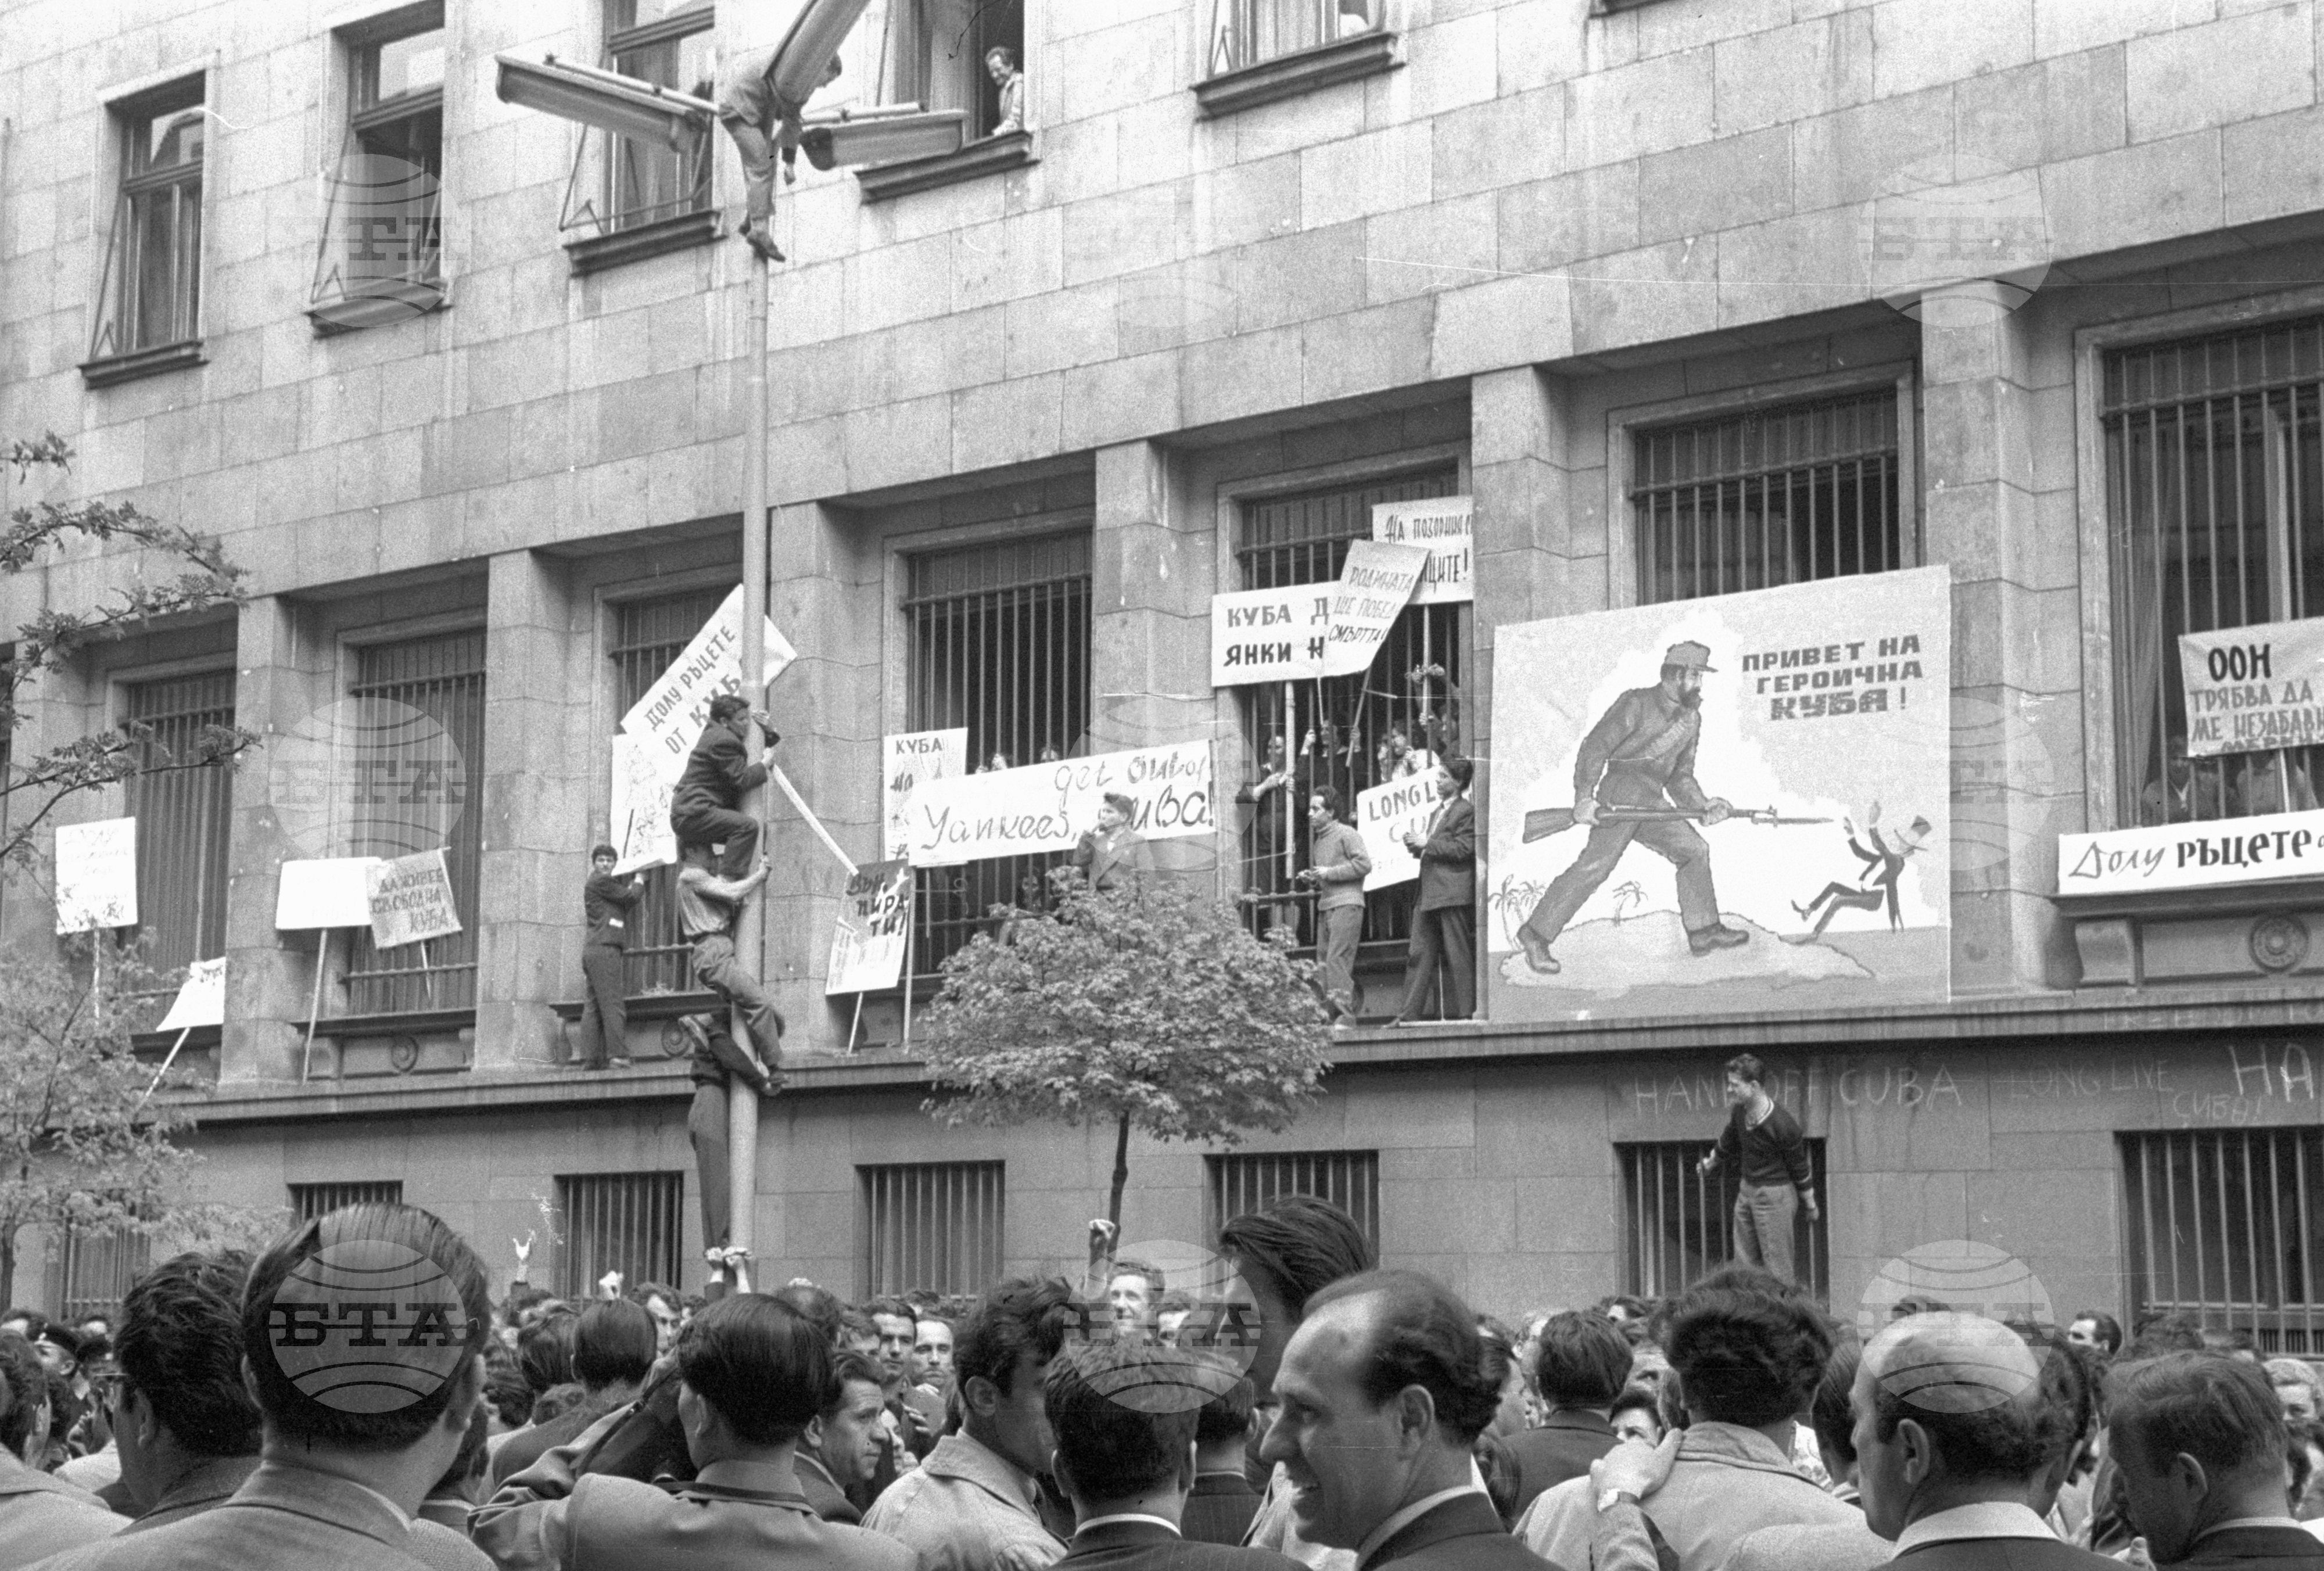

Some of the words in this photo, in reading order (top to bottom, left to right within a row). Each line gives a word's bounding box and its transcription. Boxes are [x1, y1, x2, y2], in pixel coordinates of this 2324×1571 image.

[1228, 604, 1292, 627] КУБА
[1224, 642, 1292, 667] ЯНКИ
[1743, 641, 1865, 672] ПРИВЕТ
[1878, 634, 1920, 657] НА
[2208, 643, 2272, 682] ООН
[644, 686, 682, 733] ДОЛУ
[680, 626, 736, 690] РЪЦЕТЕ
[1756, 660, 1923, 694] ГЕРОИЧНА
[2189, 684, 2272, 712] ТРЯБВА
[2280, 679, 2314, 704] ДА
[665, 727, 687, 754] ОТ
[2192, 716, 2223, 742] МЕ
[896, 737, 942, 755] КУБА
[1055, 760, 1113, 816] get
[1128, 751, 1185, 784] out
[1368, 784, 1421, 822] LONG
[2068, 841, 2165, 879] Долу
[379, 878, 399, 894] ДА
[410, 908, 449, 933] КУБА
[1839, 1064, 1961, 1111] CUBA
